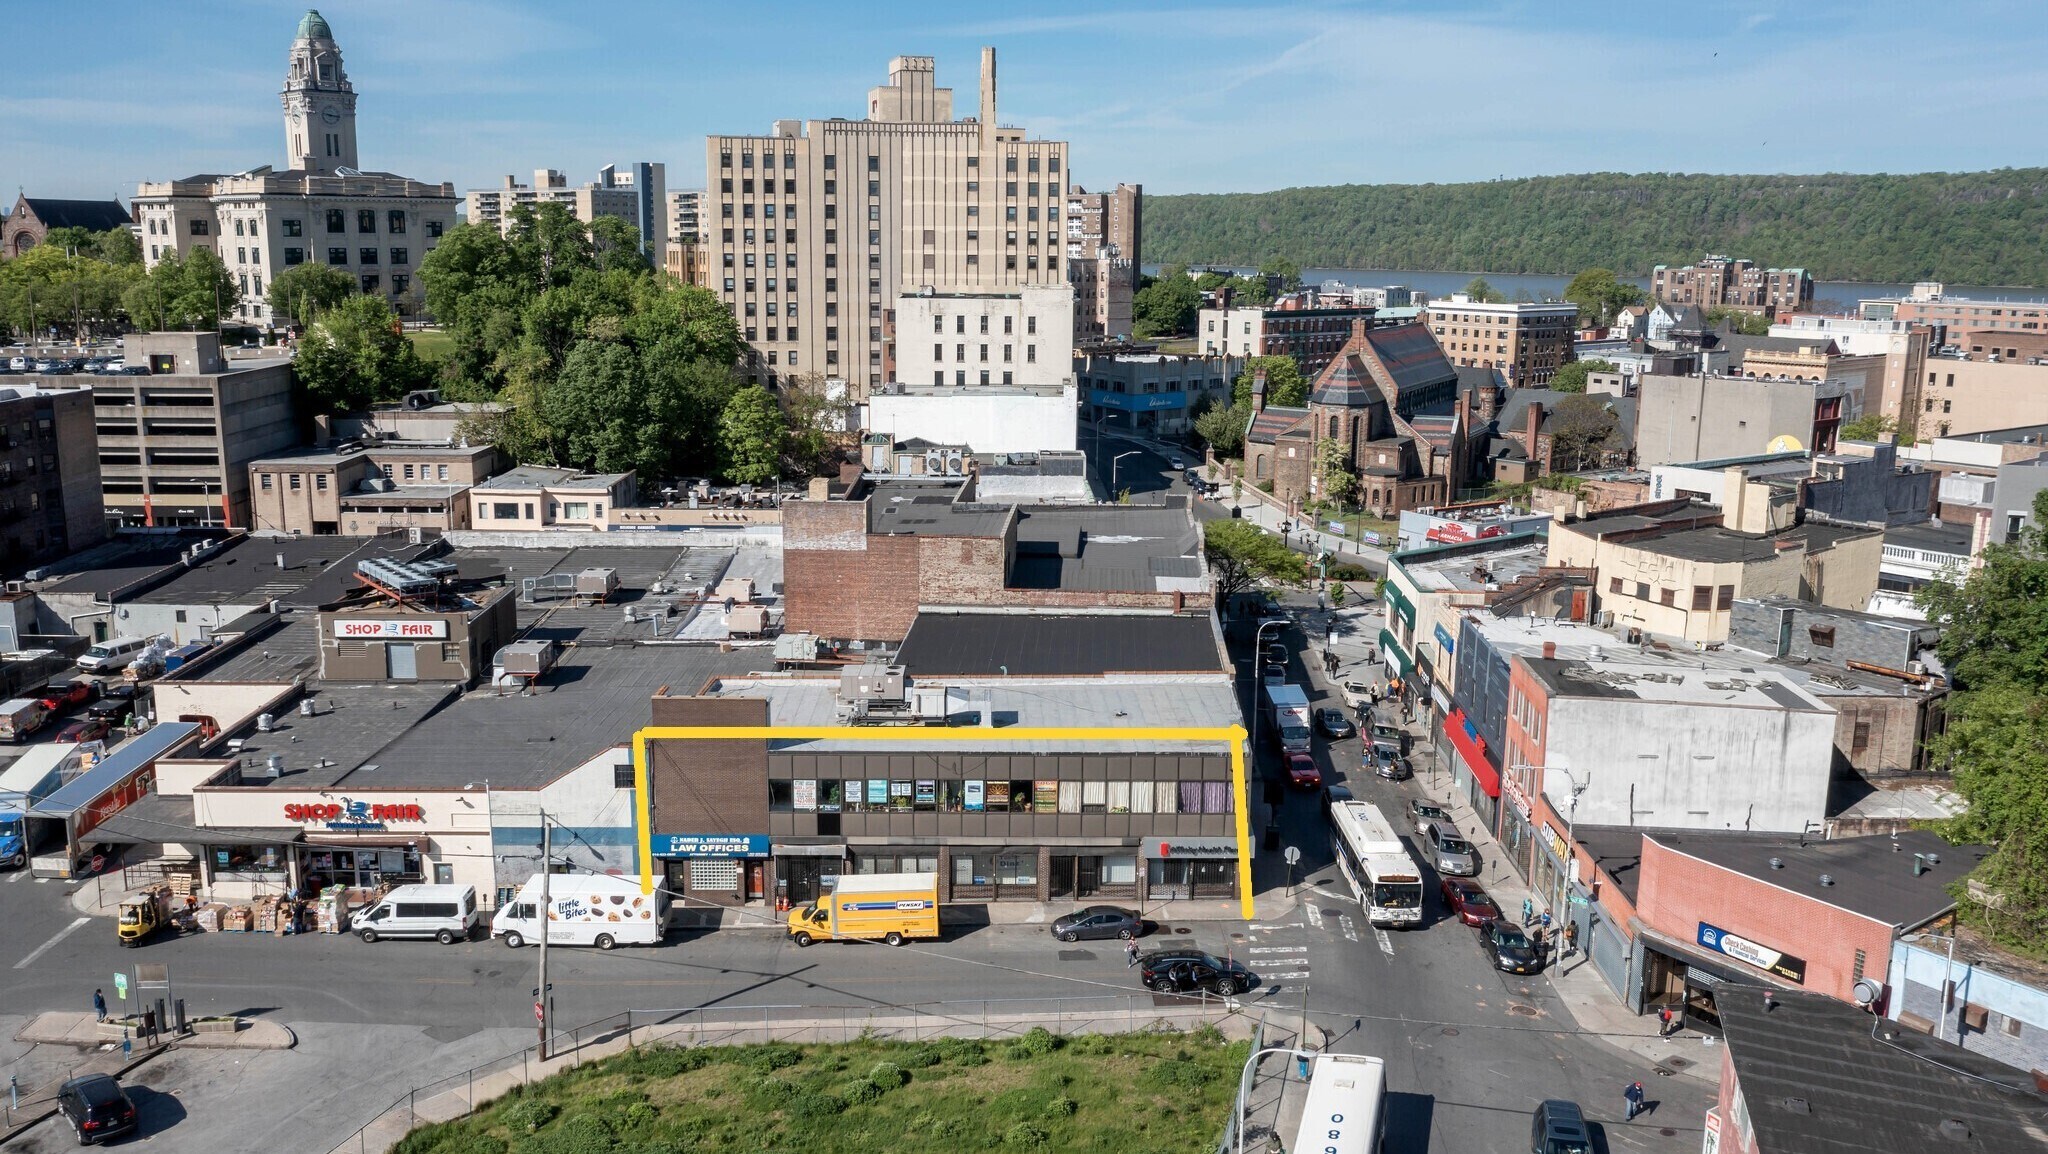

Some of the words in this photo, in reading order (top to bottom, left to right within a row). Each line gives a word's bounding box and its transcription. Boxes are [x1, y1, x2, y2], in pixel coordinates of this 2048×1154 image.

[345, 624, 382, 635] SHOP
[402, 624, 433, 635] FAIR
[284, 804, 340, 820] SHOP
[372, 804, 421, 820] FAIR
[558, 899, 580, 914] Little
[565, 907, 588, 920] Bites
[1725, 937, 1739, 949] Check
[1740, 942, 1759, 957] Cashing
